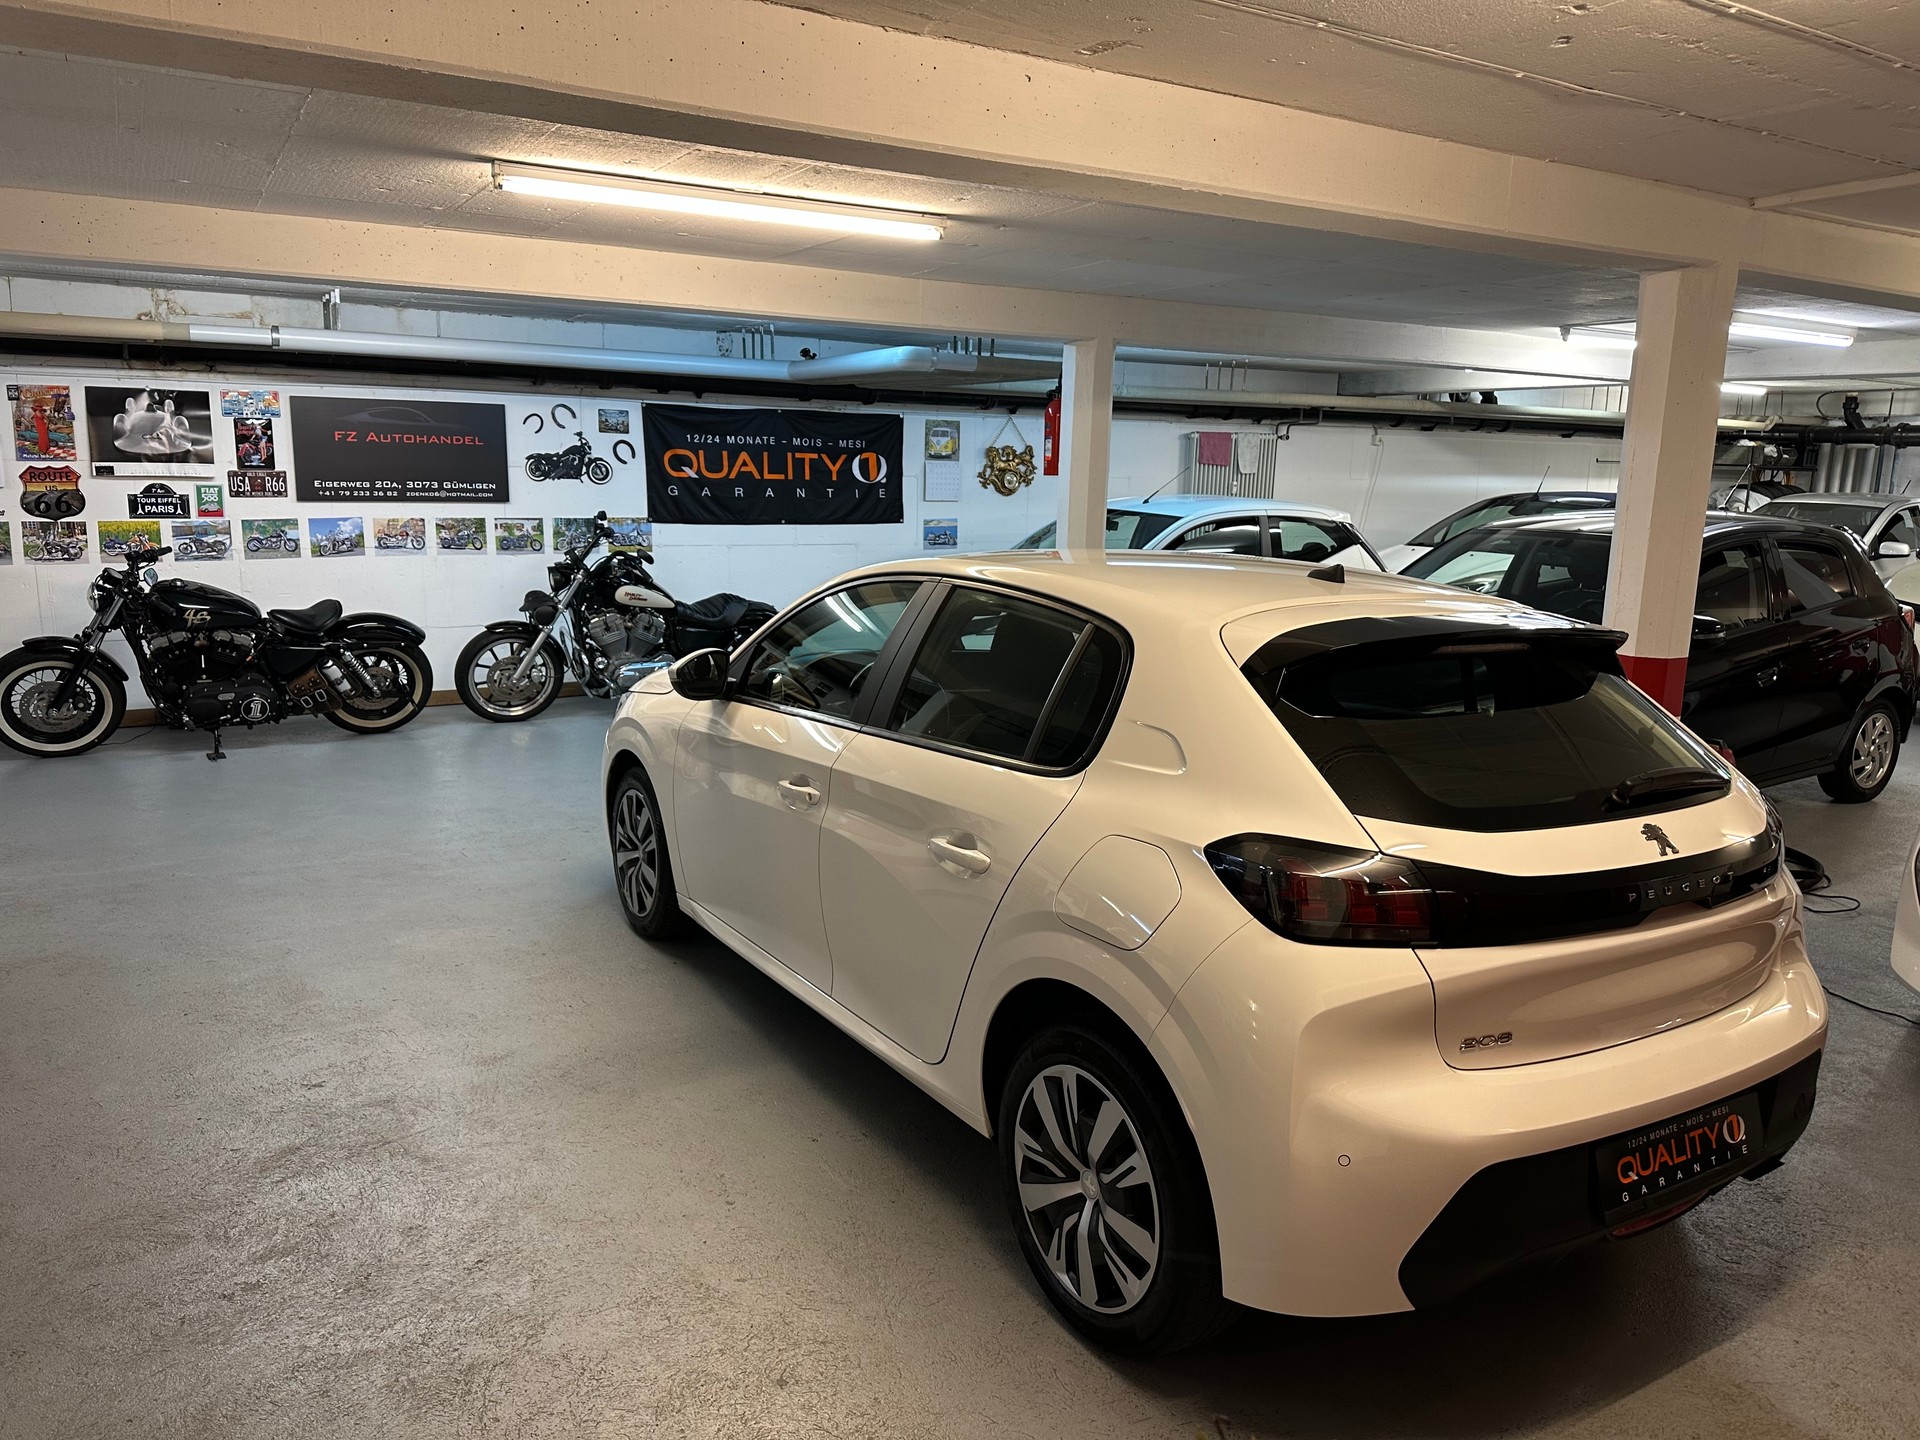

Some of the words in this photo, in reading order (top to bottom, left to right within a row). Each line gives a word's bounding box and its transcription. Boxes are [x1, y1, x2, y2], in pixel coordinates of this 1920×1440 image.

[334, 431, 357, 442] FZ
[366, 432, 484, 445] AUTOHANDEL
[686, 434, 720, 444] 12/24
[726, 436, 776, 445] MONATE
[792, 438, 822, 447] MOIS
[838, 439, 866, 448] MESI
[663, 448, 848, 481] QUALITY
[28, 471, 72, 481] ROUTE
[230, 476, 251, 492] USA
[265, 476, 285, 492] R66
[201, 494, 218, 502] 500
[667, 485, 886, 498] GARANTIE
[34, 492, 72, 513] 66
[1628, 872, 1734, 902] PEUGEOT
[1460, 1032, 1512, 1050] 208
[1628, 1136, 1647, 1148] 12/24
[1650, 1124, 1678, 1140] MONATE
[1686, 1115, 1704, 1129] MOIS
[1712, 1106, 1729, 1118] MESI
[1617, 1122, 1720, 1184] QUALITY
[1622, 1144, 1748, 1202] GARANTIE
